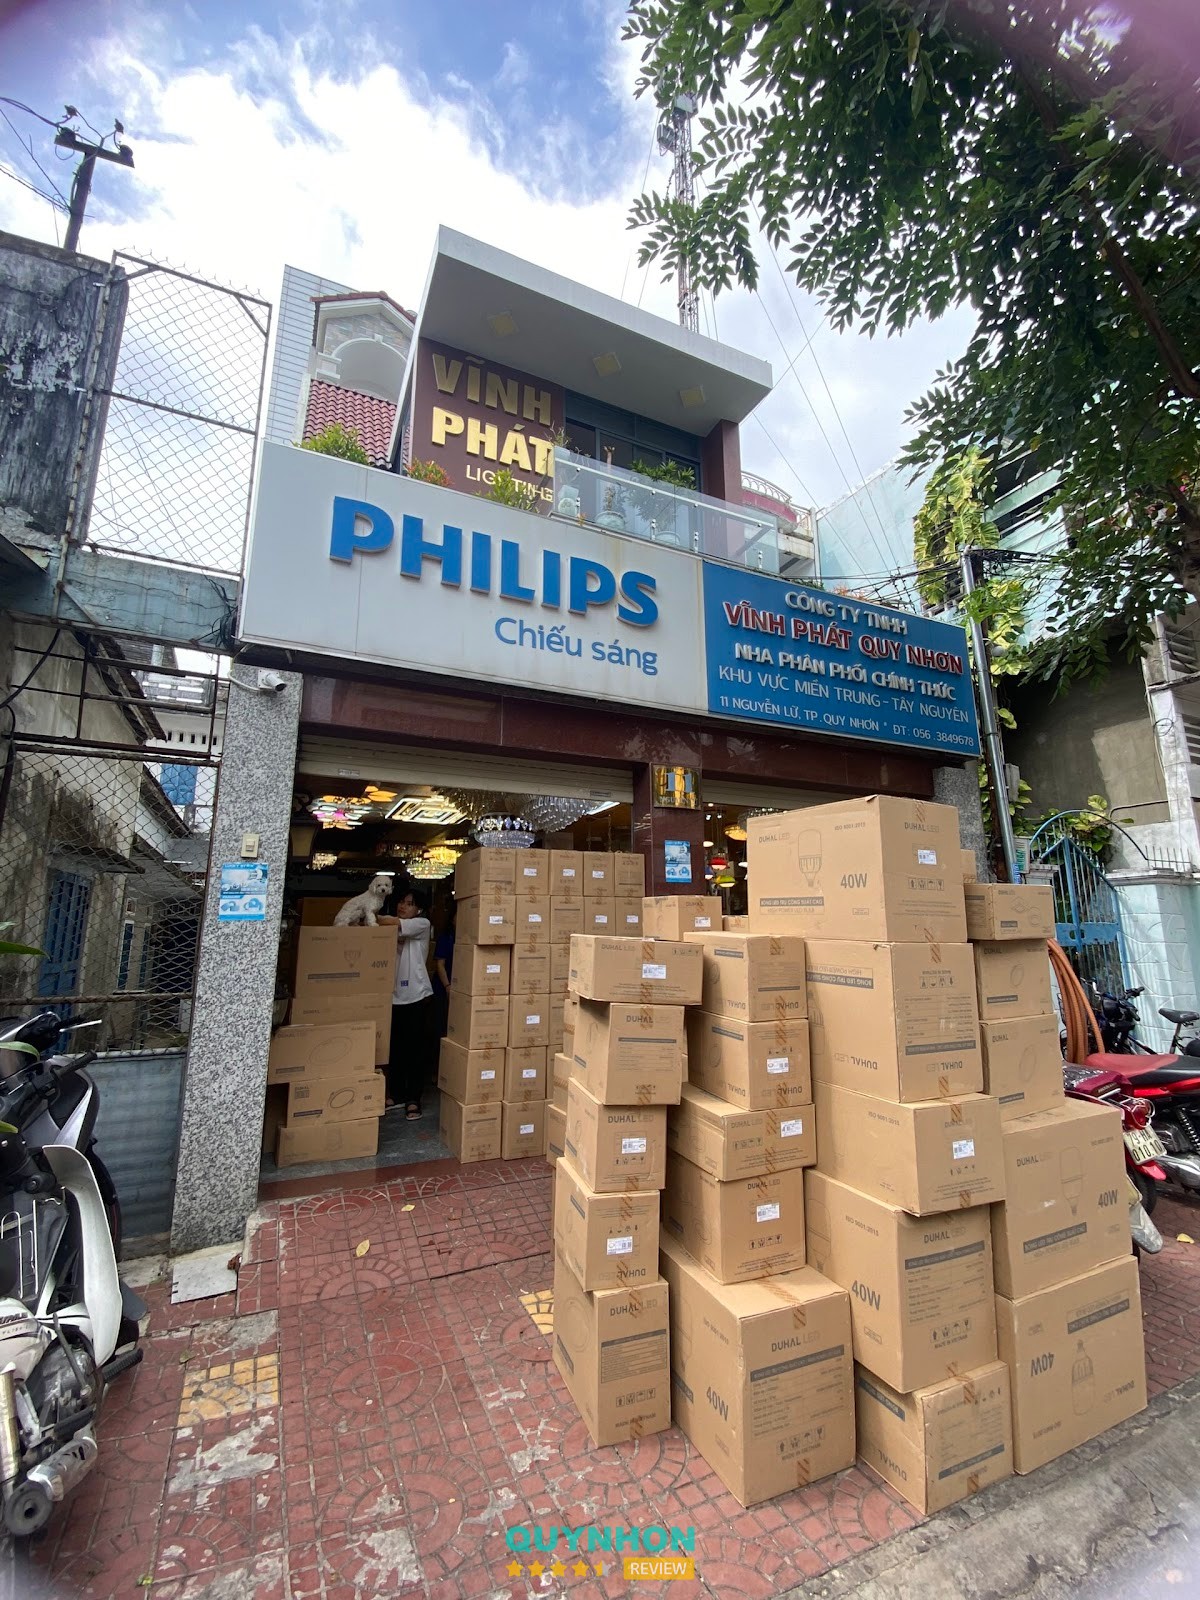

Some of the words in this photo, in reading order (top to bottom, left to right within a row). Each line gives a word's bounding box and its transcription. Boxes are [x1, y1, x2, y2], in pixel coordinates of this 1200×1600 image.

[432, 354, 551, 427] VĨNH
[432, 406, 554, 477] PHÁT
[329, 496, 659, 627] PHILIPS
[785, 591, 835, 617] CÔNG
[838, 604, 860, 623] TY
[863, 611, 908, 635] TNHH
[494, 617, 583, 658] Chiếu
[591, 639, 659, 676] sáng
[723, 600, 786, 636] VĨNH
[791, 621, 853, 650] PHÁT
[859, 634, 902, 661] QUY
[905, 644, 963, 675] NHƠN
[779, 652, 825, 675] PHÂN
[829, 662, 868, 683] PHỐI
[871, 671, 915, 692] CHÍNH
[917, 680, 957, 701] THỨC
[719, 665, 752, 684] KHU
[757, 672, 790, 692] VỰC
[795, 679, 829, 699] MIỀN
[834, 686, 880, 707] TRUNG
[891, 697, 914, 713] TÂY
[919, 702, 969, 723] NGUYÊN
[720, 696, 729, 708] 11
[732, 698, 780, 715] NGUYỄN
[823, 713, 846, 726] QUY
[849, 717, 879, 731] NHƠN
[893, 725, 911, 736] ĐT:
[904, 822, 926, 832] DUHAL
[840, 873, 868, 888] 40W
[371, 960, 389, 968] 40W
[626, 1015, 654, 1023] DUHAL
[851, 1056, 878, 1070] DUHAL
[941, 1060, 963, 1071] DUHAL
[607, 1115, 636, 1124] DUHAL
[731, 1120, 750, 1129] DUHAL
[1017, 1155, 1039, 1167] DUHAL
[747, 1181, 768, 1190] DUHAL
[1098, 1188, 1119, 1209] 40W
[924, 1231, 950, 1244] DUHAL
[851, 1280, 881, 1311] 40W
[610, 1303, 639, 1317] DUHAL
[771, 1337, 801, 1353] DUHAL
[1030, 1352, 1055, 1378] 40W
[706, 1386, 729, 1422] 40W
[879, 1449, 907, 1482] DUHAL
